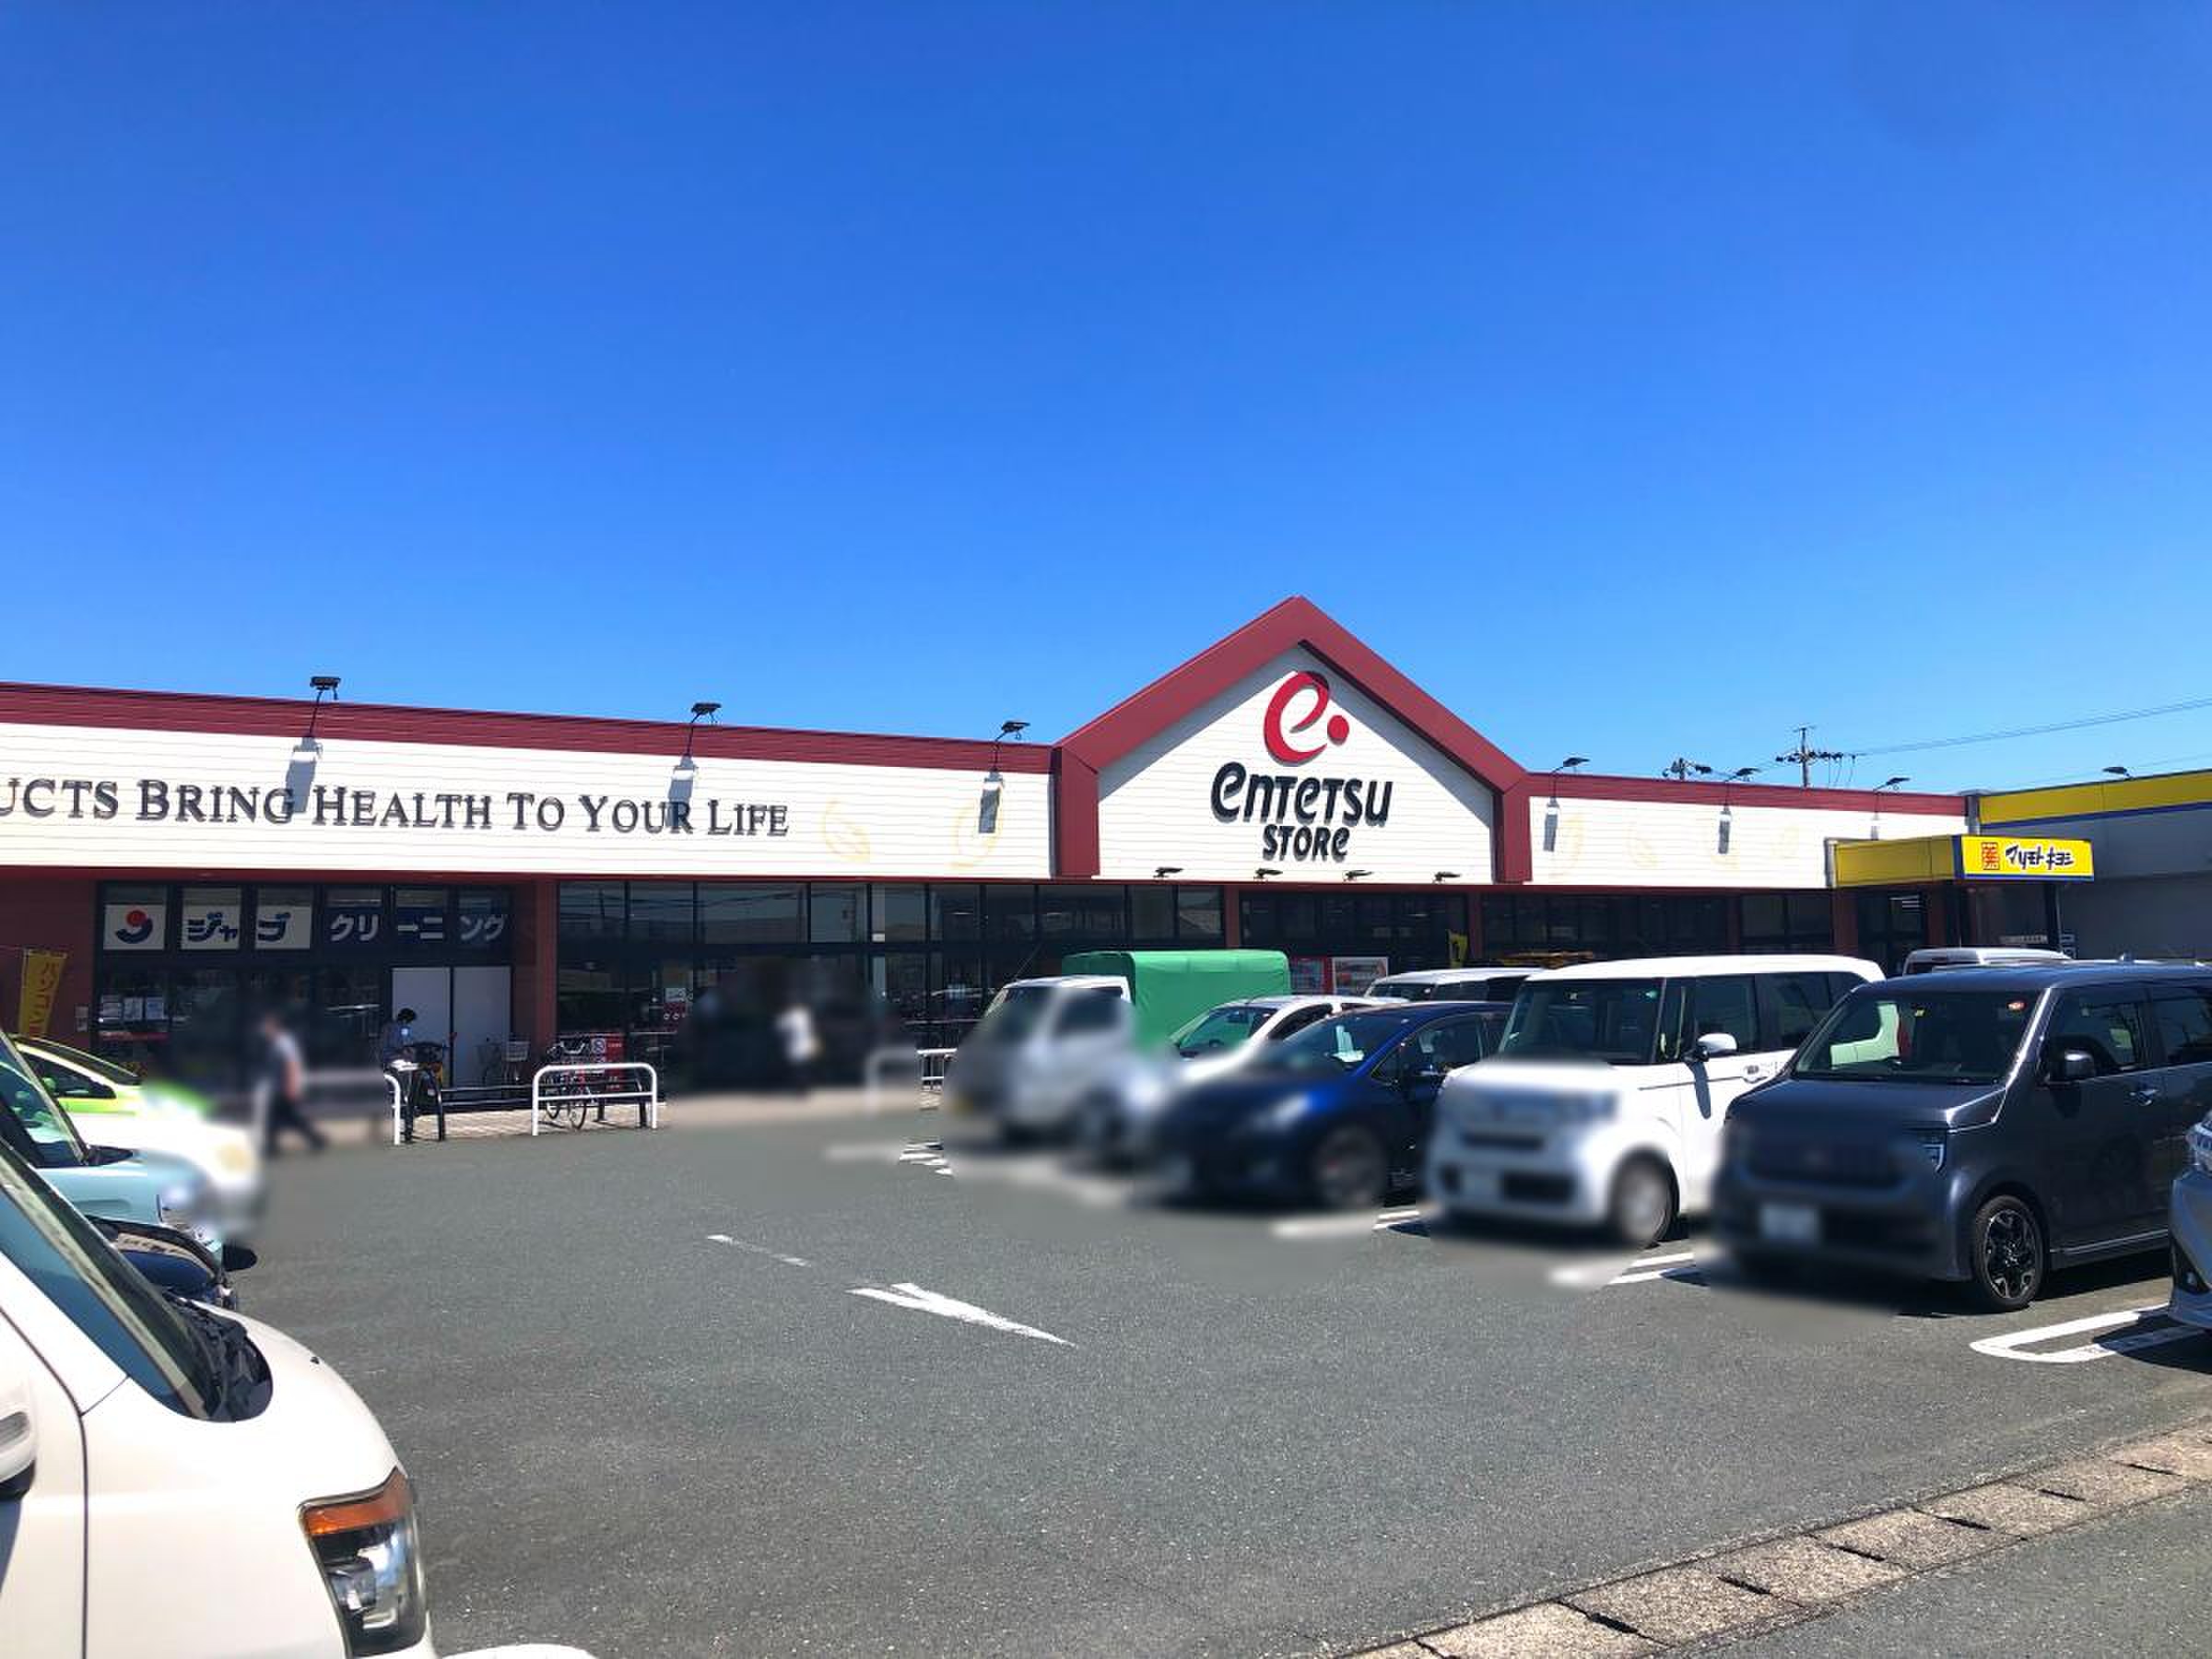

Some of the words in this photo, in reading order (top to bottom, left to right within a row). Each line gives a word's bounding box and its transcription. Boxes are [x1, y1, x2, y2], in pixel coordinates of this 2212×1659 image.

[135, 779, 294, 824] BRING
[312, 784, 493, 830] HEALTH
[506, 792, 565, 831] TO
[578, 794, 694, 834] YOUR
[707, 799, 789, 837] LIFE
